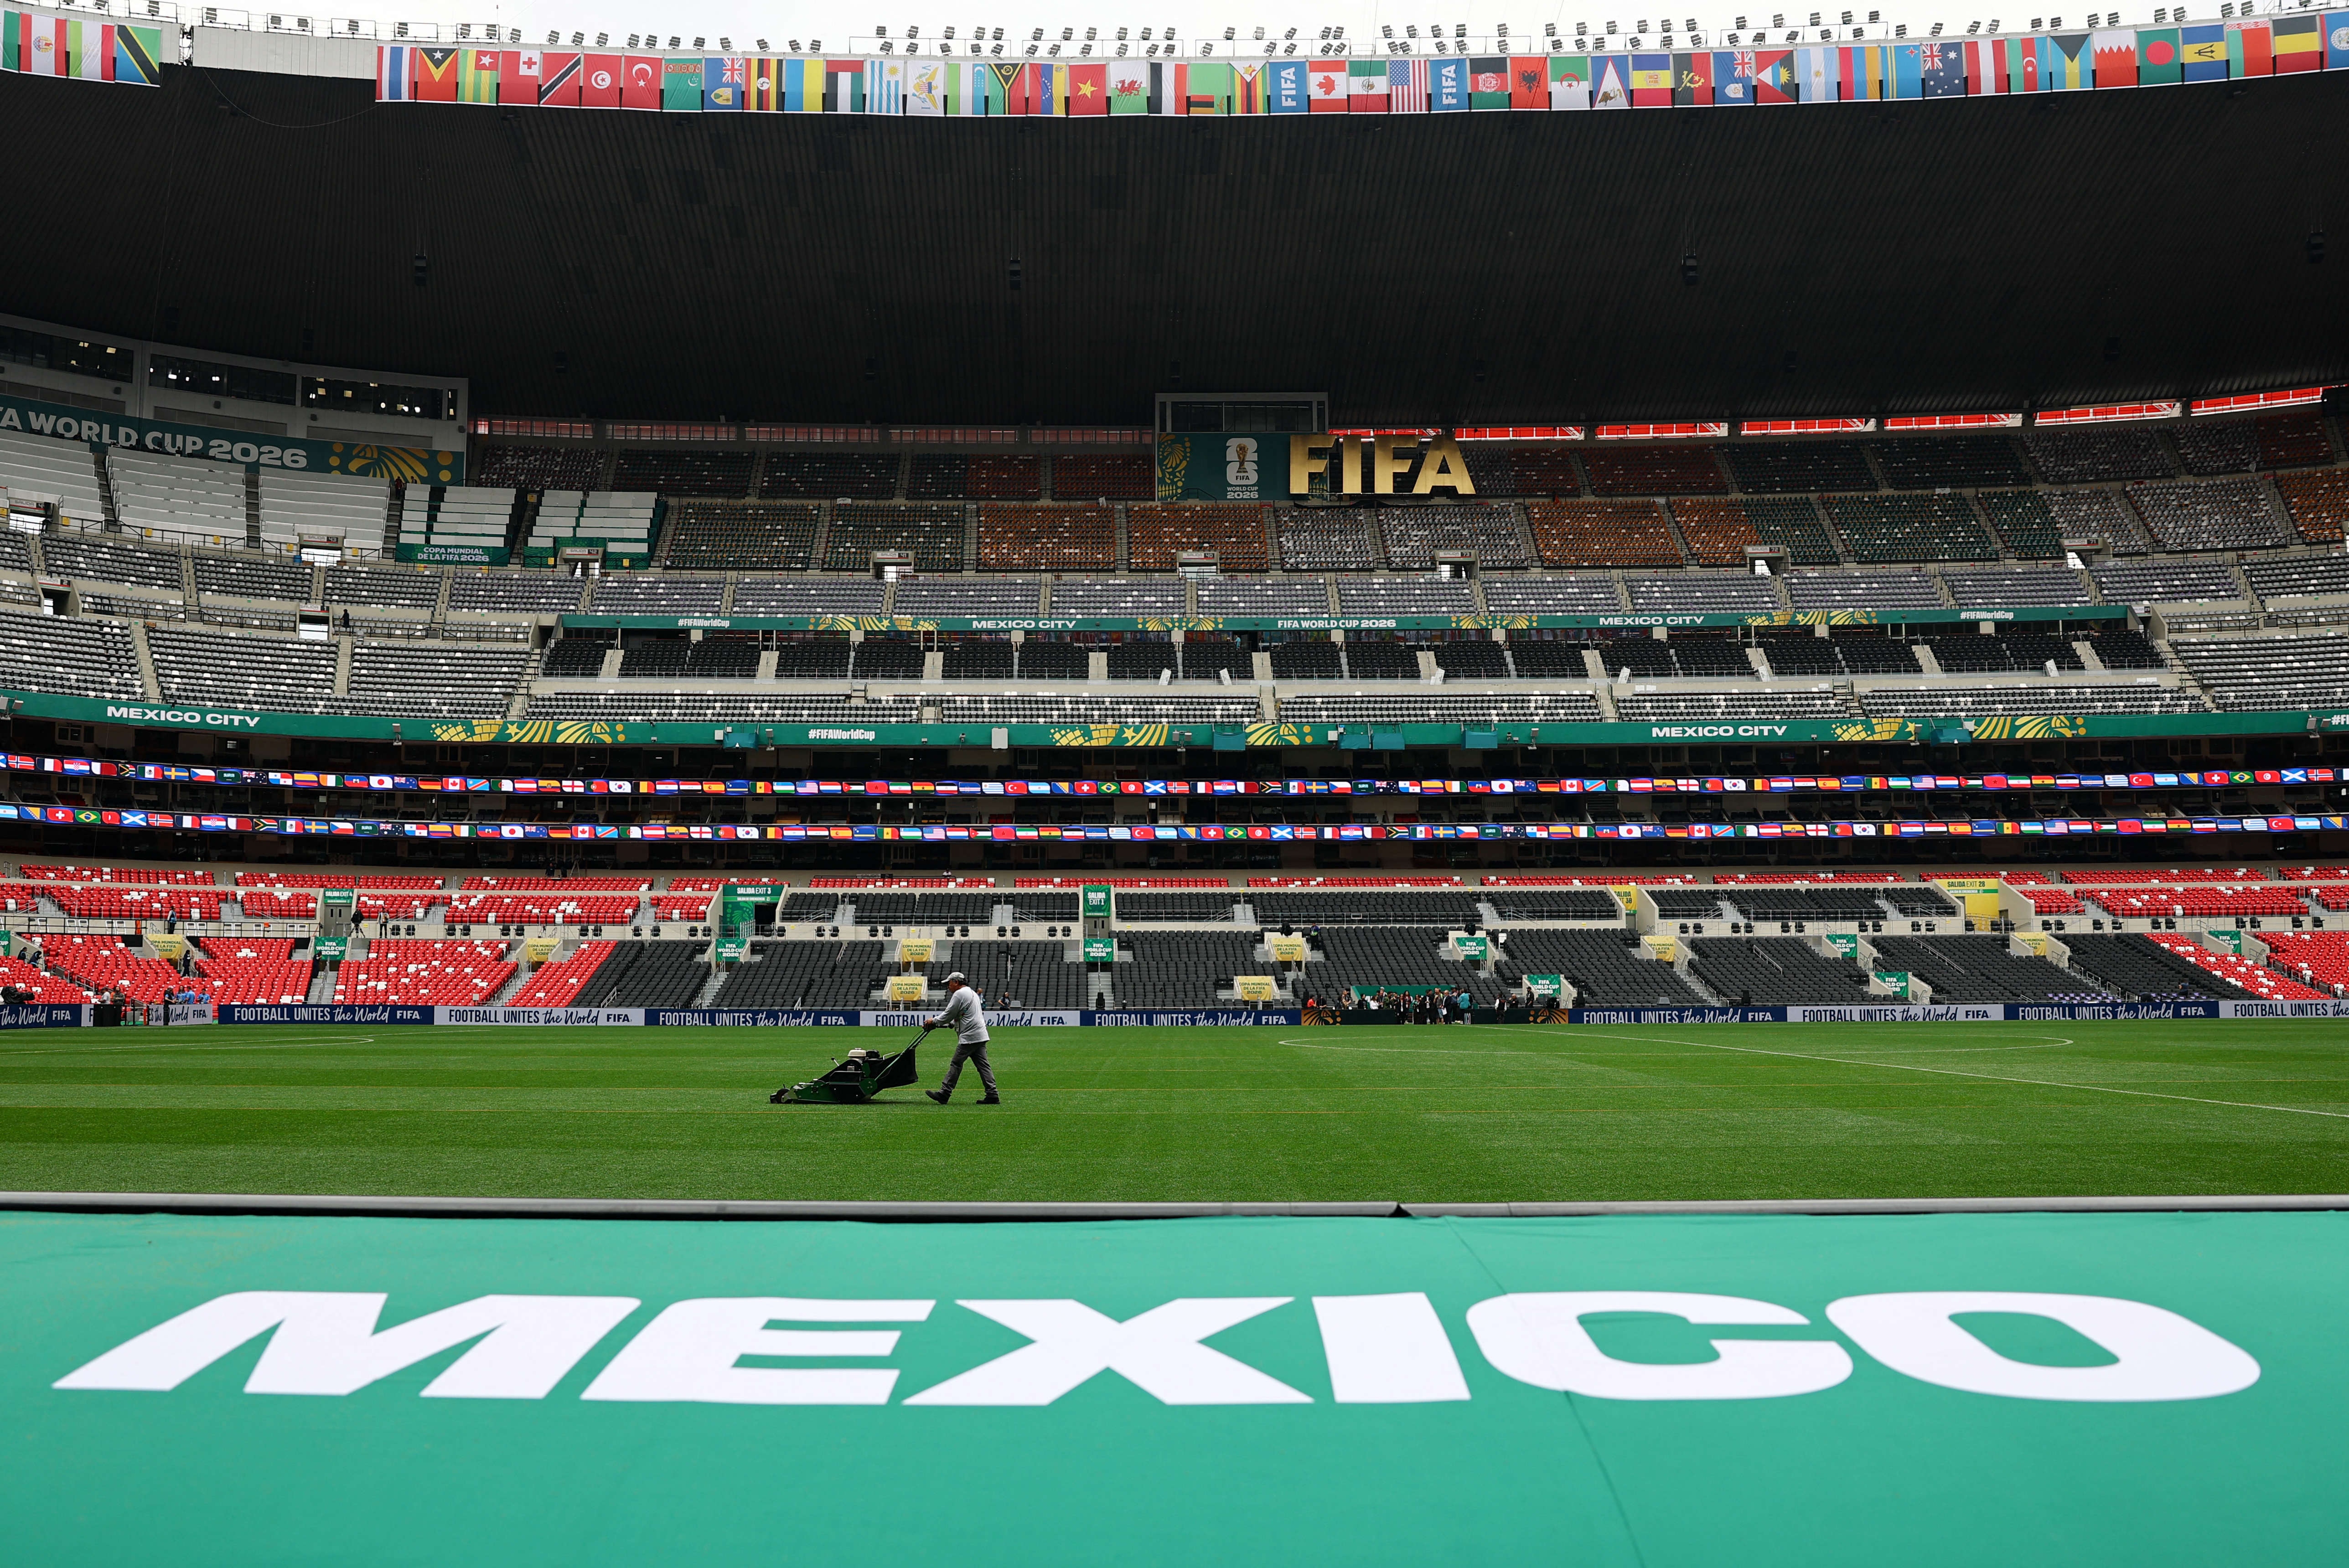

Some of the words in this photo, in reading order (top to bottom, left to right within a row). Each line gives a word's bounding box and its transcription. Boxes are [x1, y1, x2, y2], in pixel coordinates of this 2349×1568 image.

[1281, 67, 1297, 106] FIFA
[1442, 64, 1458, 104] FIFA
[28, 411, 138, 447] WORLD
[145, 431, 203, 454] CUP
[209, 439, 307, 468] 2026
[1290, 434, 1476, 494] FIFA
[1599, 616, 1663, 625] MEXICO
[1666, 615, 1704, 624] CITY
[1960, 610, 2014, 620] #FIFAWorldCup
[678, 618, 730, 629] #FIFAWorldCup
[972, 619, 1035, 629] MEXICO
[1038, 620, 1076, 629] CITY
[1278, 620, 1300, 628] FIFA
[1301, 620, 1338, 628] WORLD
[1339, 620, 1359, 628] CUP
[1361, 619, 1397, 628] 2026
[107, 706, 202, 723] MEXICO
[205, 712, 260, 727] CITY
[808, 728, 875, 741] #FIFAWorldCup
[1652, 726, 1733, 738] MEXICO
[1738, 725, 1787, 736] CITY
[0, 1007, 17, 1025] the
[19, 1006, 47, 1025] World
[52, 1010, 71, 1020] FIFA
[154, 1008, 162, 1021] the
[168, 1006, 189, 1023] World
[193, 1009, 207, 1018] FIFA
[235, 1008, 290, 1021] FOOTBALL
[294, 1008, 330, 1021] UNITES
[333, 1006, 353, 1021] the
[354, 1006, 390, 1021] World
[397, 1010, 419, 1019] FIFA
[449, 1009, 500, 1023] FOOTBALL
[504, 1010, 539, 1023] UNITES
[542, 1008, 563, 1024] the
[564, 1009, 600, 1024] World
[607, 1013, 630, 1022] FIFA
[1583, 1011, 1637, 1023] FOOTBALL
[1641, 1011, 1678, 1023] UNITES
[1681, 1009, 1703, 1023] the
[1705, 1009, 1741, 1022] World
[1748, 1012, 1772, 1021] FIFA
[1803, 1009, 1855, 1021] FOOTBALL
[1859, 1009, 1896, 1021] UNITES
[1899, 1007, 1920, 1021] the
[1922, 1006, 1958, 1021] World
[1965, 1010, 1989, 1019] FIFA
[2019, 1007, 2071, 1020] FOOTBALL
[2075, 1006, 2112, 1020] UNITES
[2115, 1005, 2136, 1019] the
[2138, 1004, 2174, 1019] World
[2181, 1007, 2204, 1016] FIFA
[2235, 1004, 2287, 1016] FOOTBALL
[2291, 1003, 2327, 1016] UNITES
[2330, 1001, 2349, 1016] the
[660, 1012, 711, 1025] FOOTBALL
[716, 1012, 752, 1026] UNITES
[755, 1011, 776, 1026] the
[778, 1012, 814, 1026] World
[821, 1016, 845, 1025] FIFA
[876, 1014, 925, 1026] FOOTBALL
[997, 1012, 1034, 1026] World
[1040, 1016, 1065, 1025] FIFA
[1096, 1014, 1149, 1026] FOOTBALL
[1153, 1014, 1191, 1026] UNITES
[1194, 1012, 1216, 1026] the
[1217, 1011, 1255, 1026] World
[1262, 1016, 1286, 1024] FIFA
[51, 1290, 2261, 1401] MEXICO
